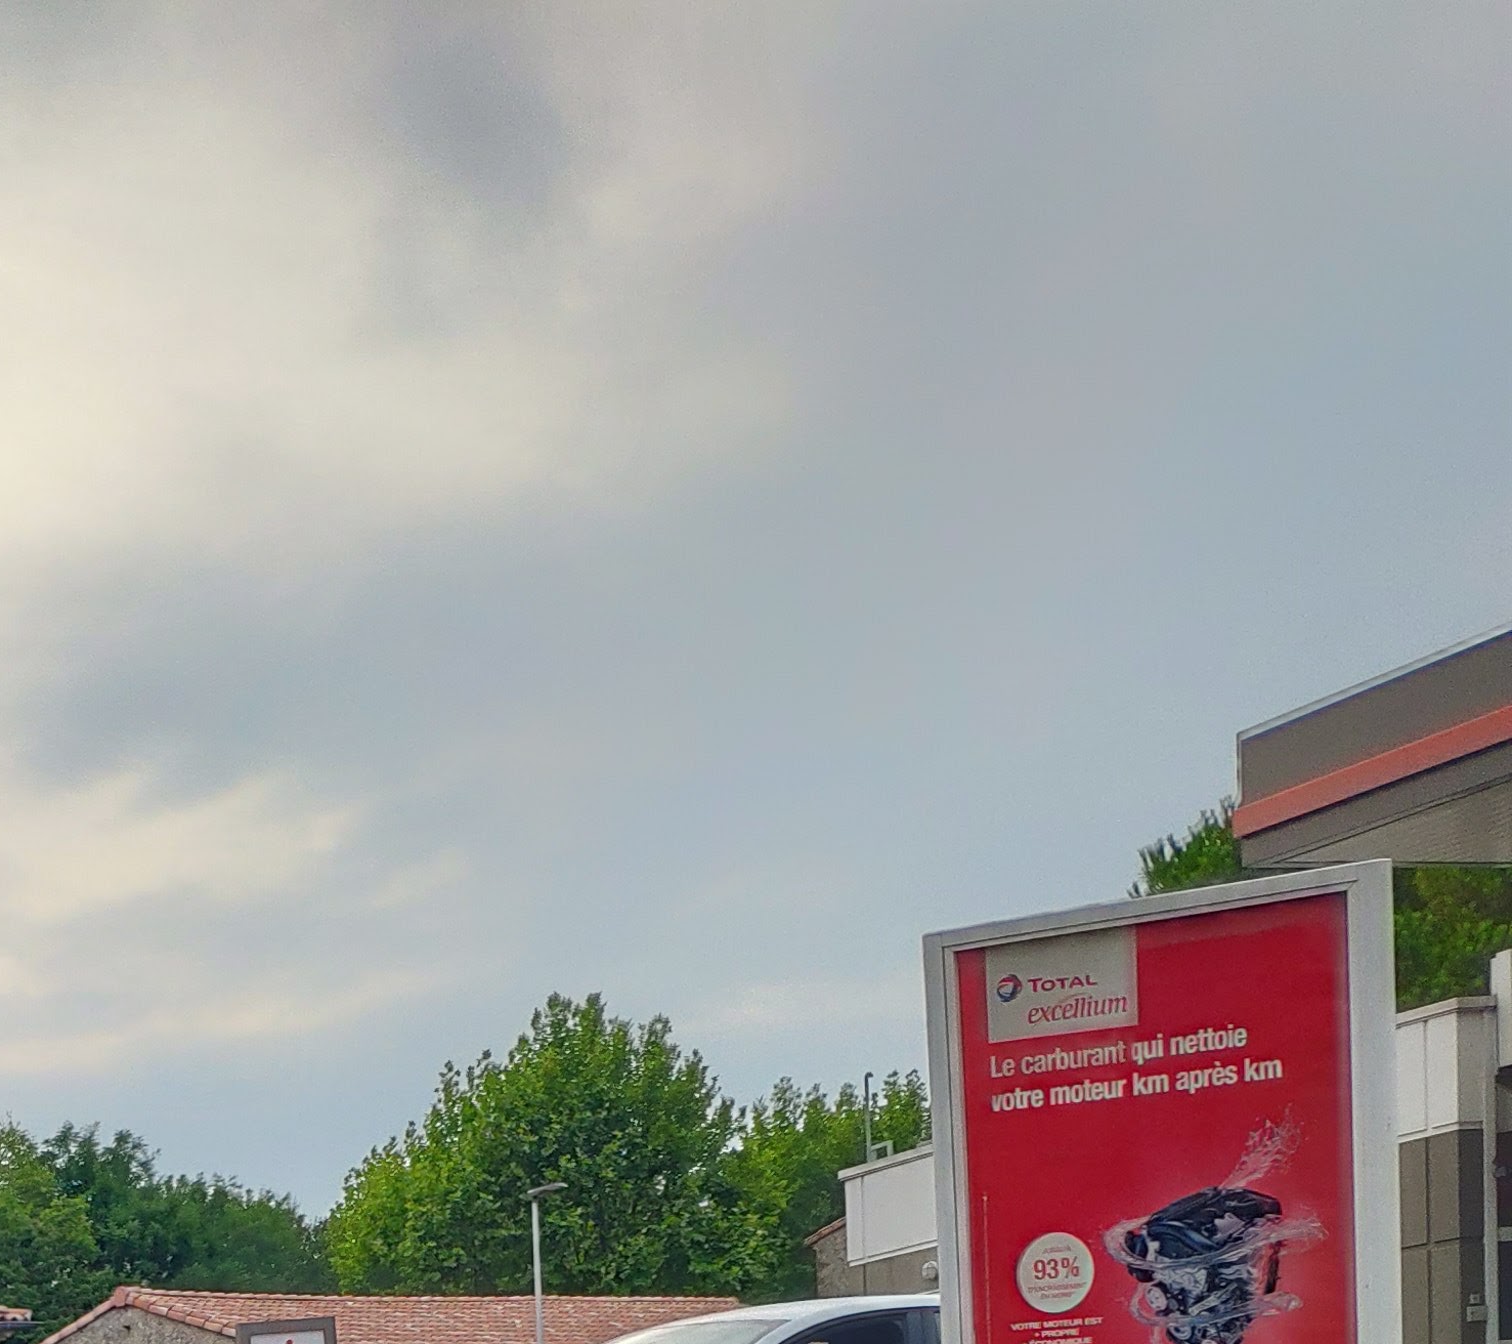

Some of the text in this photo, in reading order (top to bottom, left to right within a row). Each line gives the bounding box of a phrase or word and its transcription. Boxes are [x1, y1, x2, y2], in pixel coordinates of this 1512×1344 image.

[1027, 975, 1098, 993] TOTAL
[1027, 996, 1128, 1025] excellium
[990, 1023, 1248, 1079] Le carburant qui nettoie
[991, 1057, 1283, 1112] votre moteur km après km
[1033, 1256, 1080, 1280] 93%
[1010, 1321, 1041, 1331] VOTRE
[1043, 1318, 1083, 1328] MOTEUR
